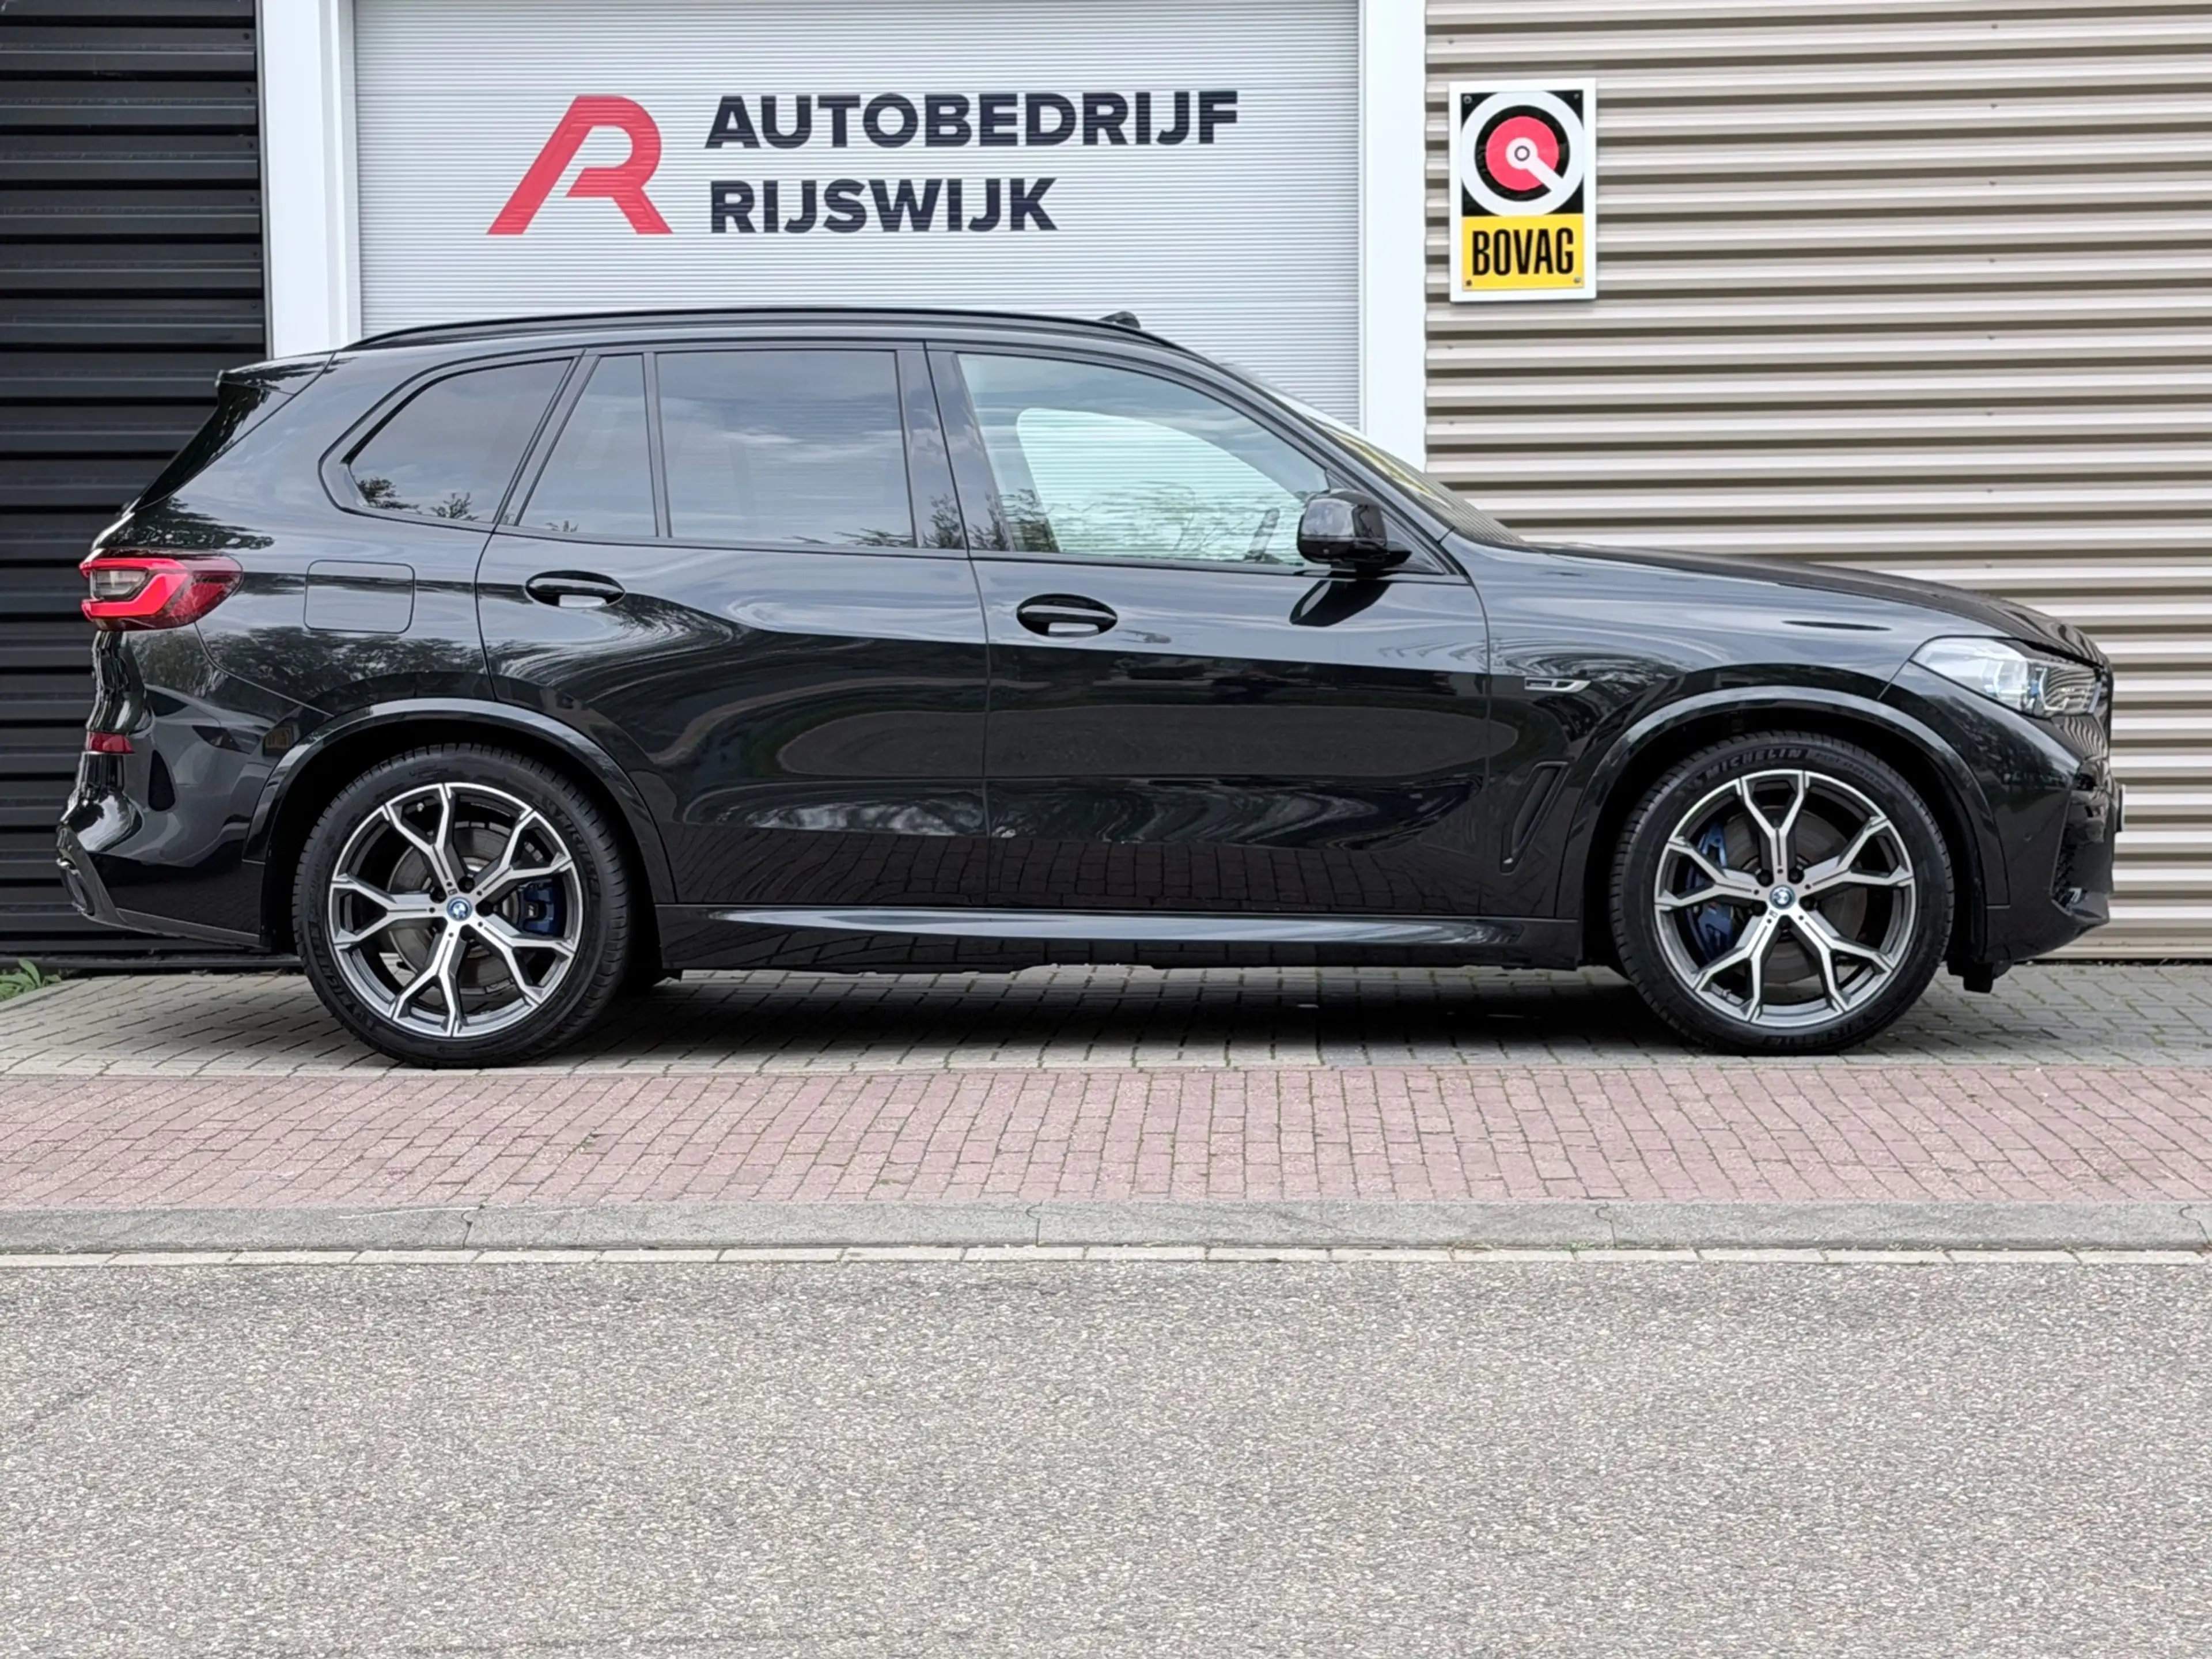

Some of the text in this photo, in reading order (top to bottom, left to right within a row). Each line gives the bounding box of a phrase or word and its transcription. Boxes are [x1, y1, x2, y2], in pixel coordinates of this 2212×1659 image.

[704, 90, 1238, 149] AUTOBEDRIJF
[711, 178, 1058, 233] RIJSWIJK
[1472, 227, 1574, 276] BOVAG
[1705, 749, 1802, 778] MICHELIN
